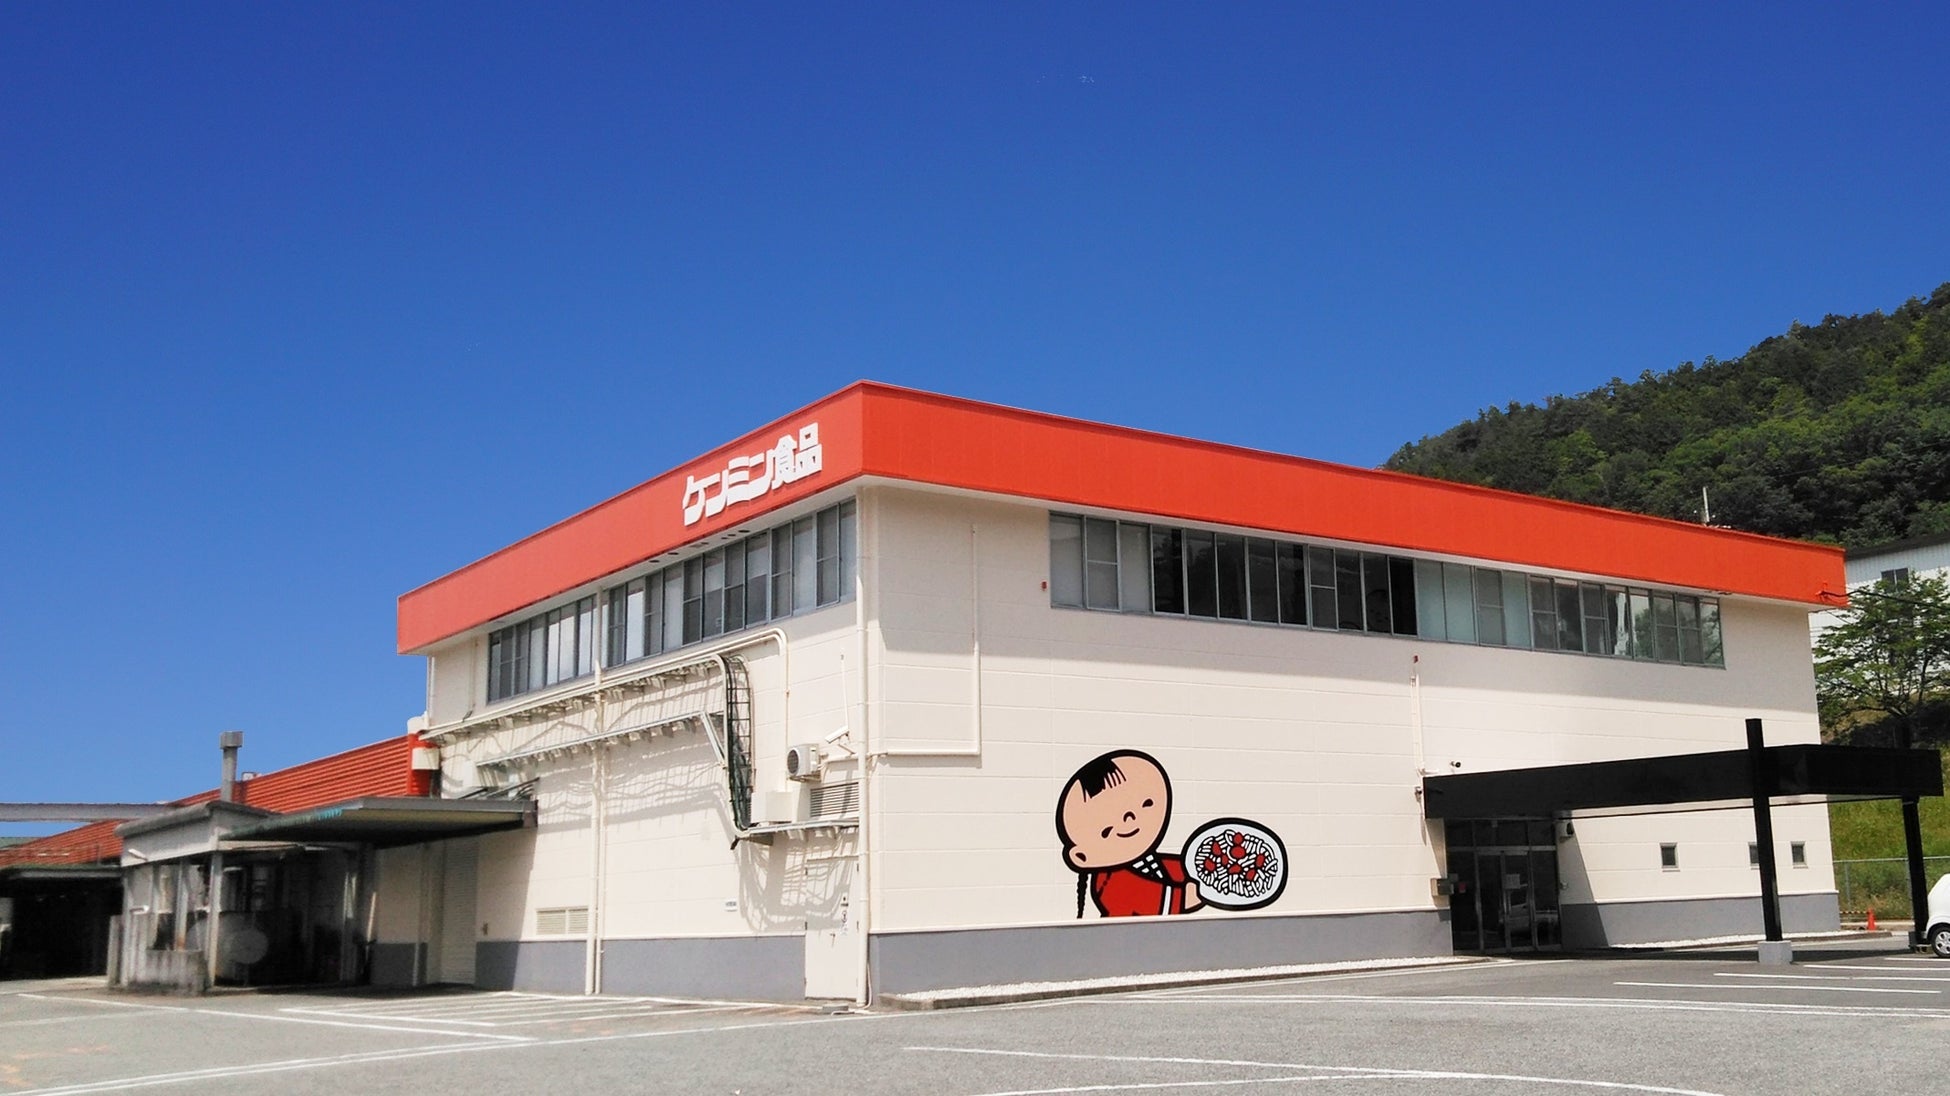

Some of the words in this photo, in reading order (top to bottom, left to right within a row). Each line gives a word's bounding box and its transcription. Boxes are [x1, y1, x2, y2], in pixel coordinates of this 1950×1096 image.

[682, 422, 823, 526] ケンミン食品
